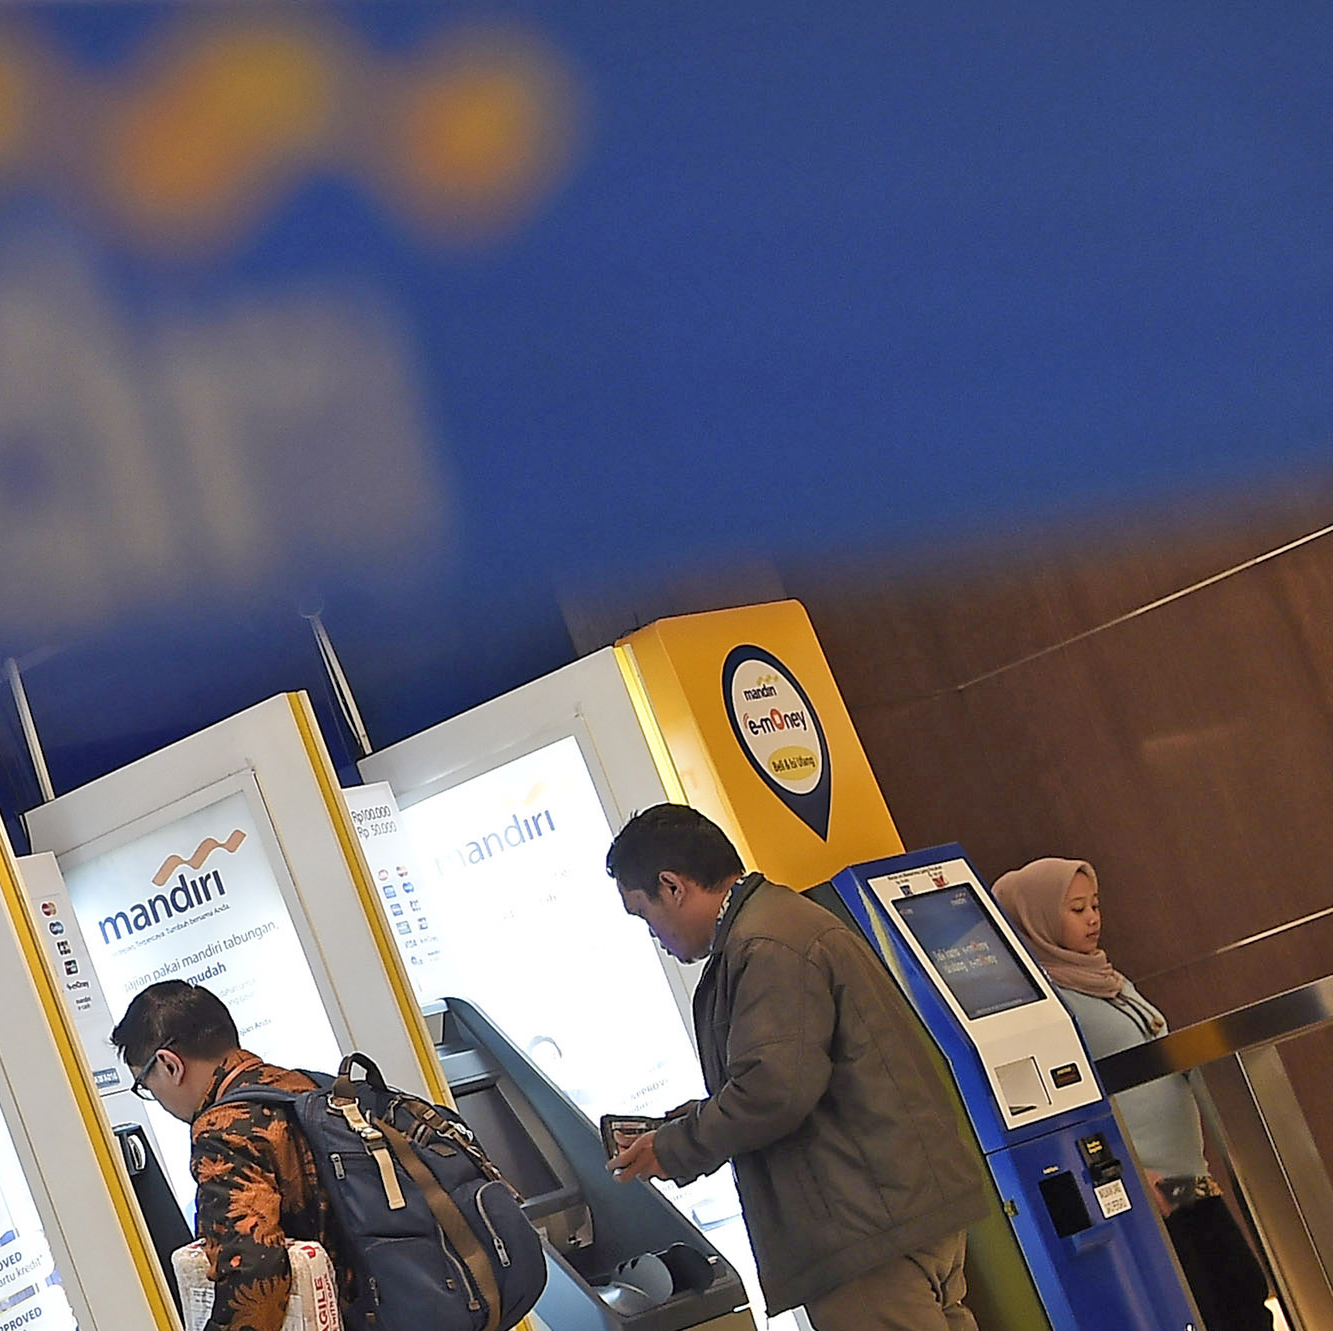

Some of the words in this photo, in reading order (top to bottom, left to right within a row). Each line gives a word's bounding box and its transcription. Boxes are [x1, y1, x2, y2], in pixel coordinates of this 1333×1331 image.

[98, 868, 226, 945] mandiri
[153, 956, 181, 984] pakai
[181, 940, 222, 968] mandiri
[186, 961, 227, 988] mudah
